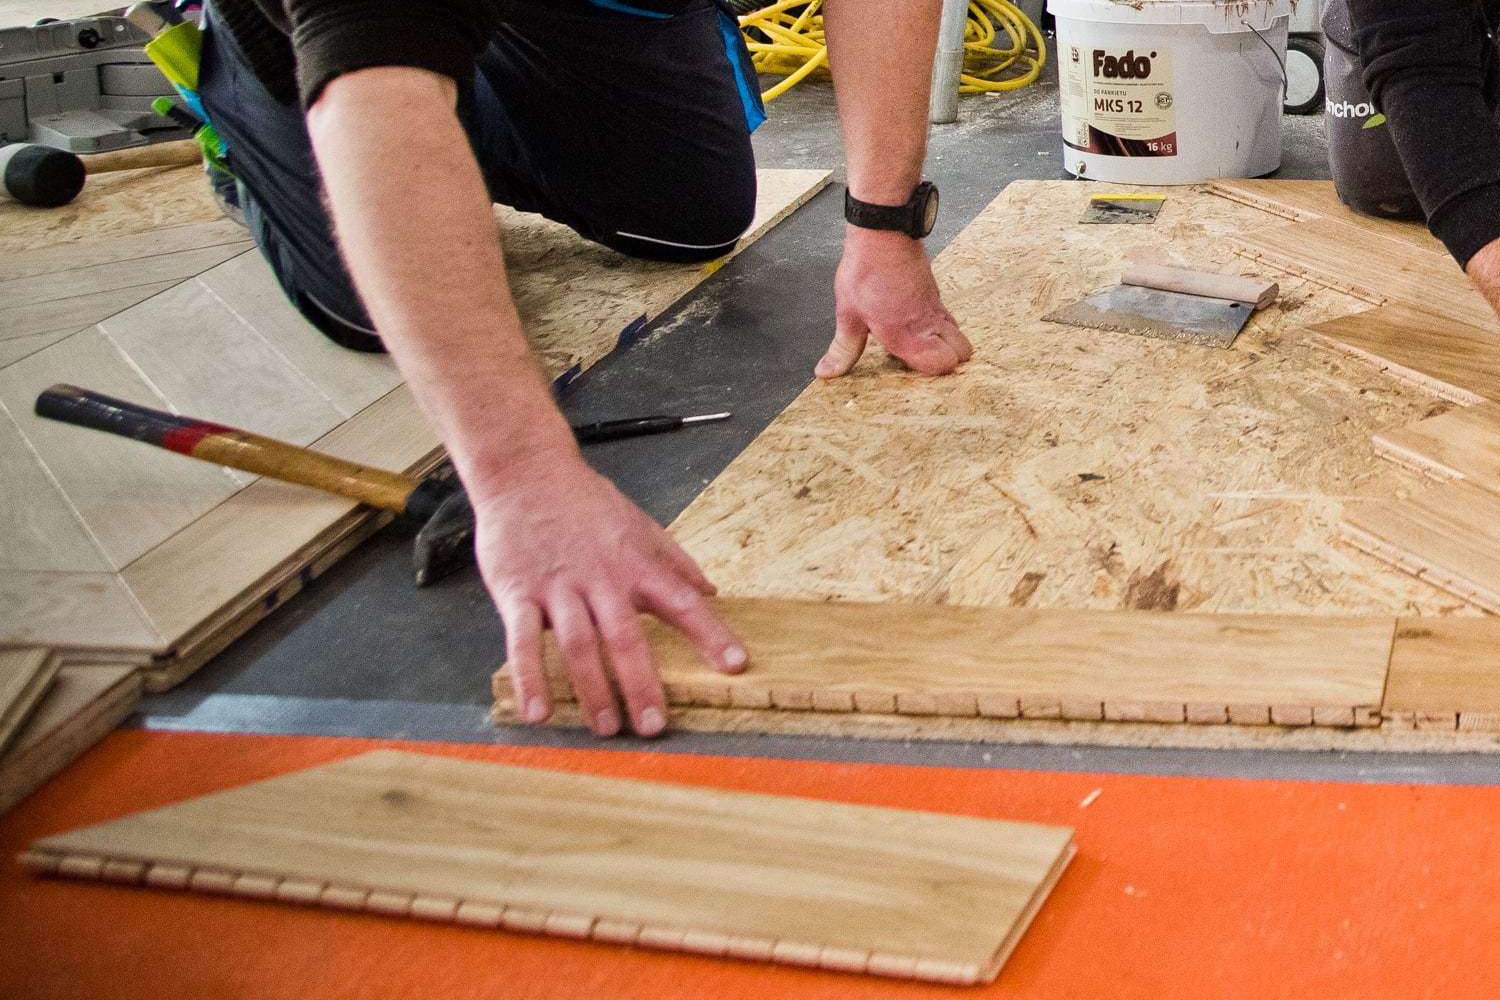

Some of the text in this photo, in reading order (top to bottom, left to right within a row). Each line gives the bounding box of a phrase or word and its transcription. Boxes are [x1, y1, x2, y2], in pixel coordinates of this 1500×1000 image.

[1092, 49, 1152, 80] Fado
[1094, 97, 1124, 113] MKS
[1127, 99, 1143, 113] 12
[1147, 141, 1173, 153] 16 kg
